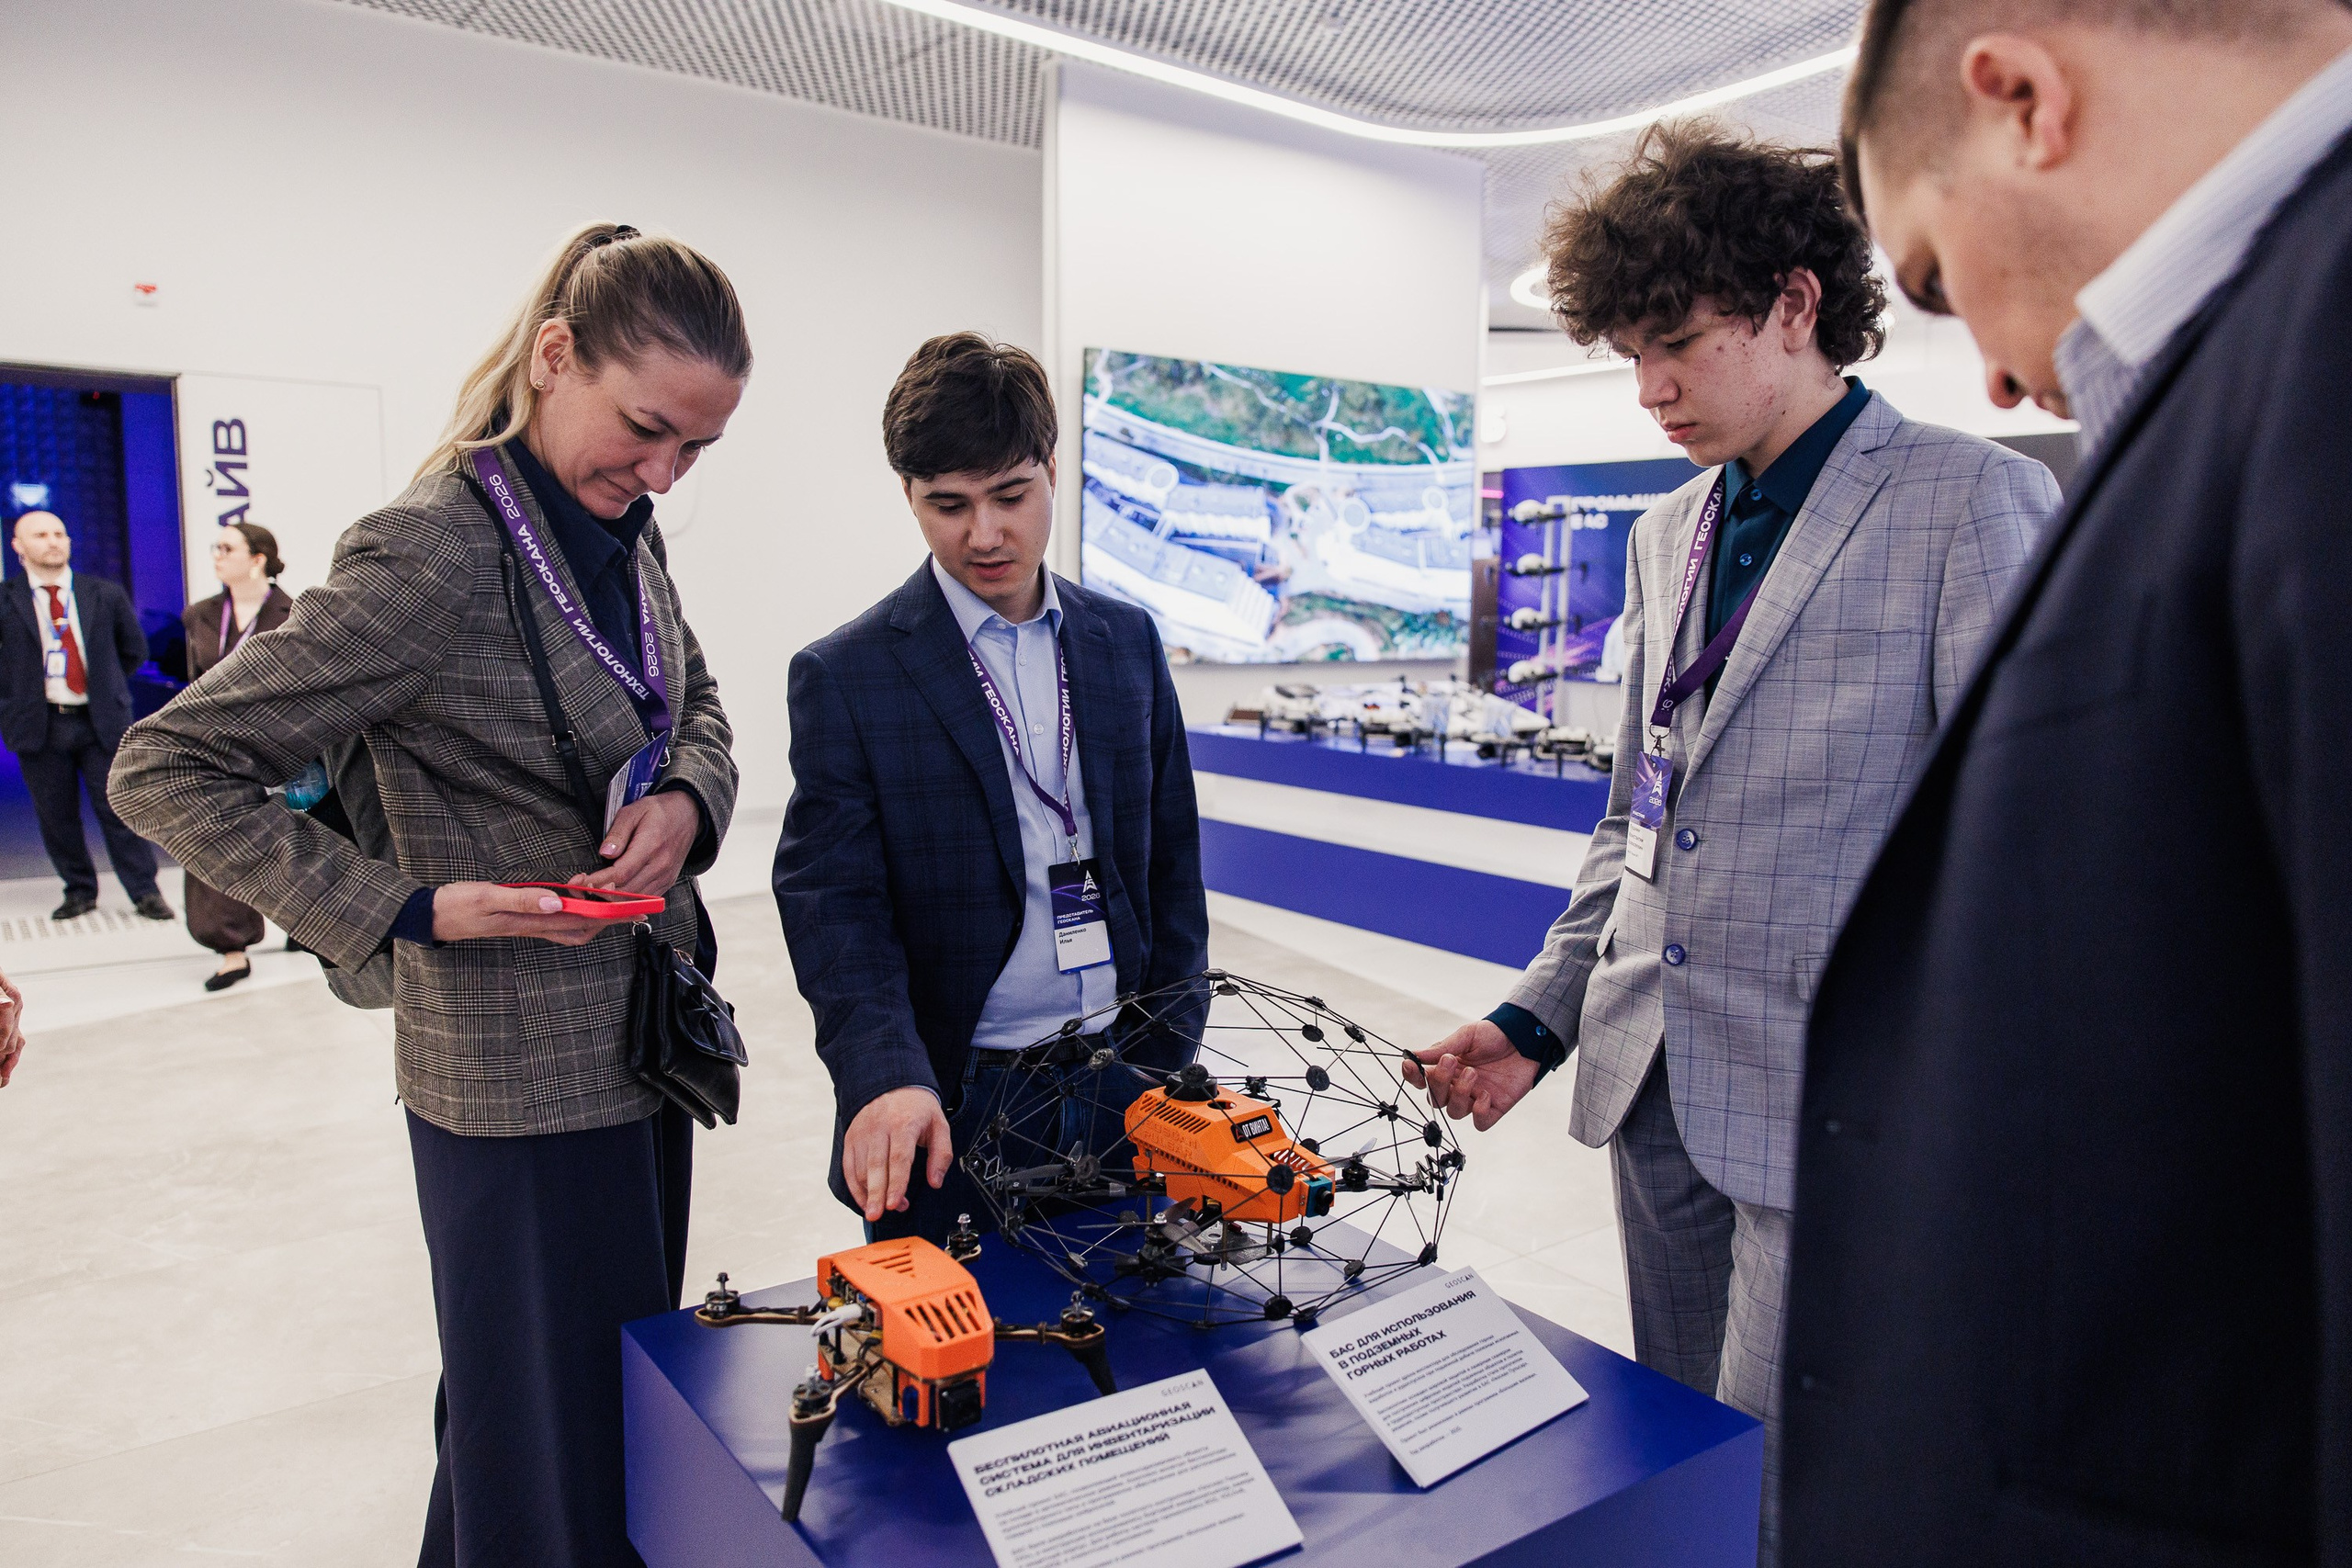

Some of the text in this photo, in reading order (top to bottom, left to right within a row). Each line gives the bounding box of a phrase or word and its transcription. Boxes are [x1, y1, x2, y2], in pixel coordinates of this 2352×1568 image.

[489, 474, 650, 700] ТЕХНОЛОГИИ ГЕОСКАНА 2026
[645, 632, 660, 677] 2026
[1081, 892, 1101, 902] 2026
[1443, 1272, 1475, 1289] GEOSCAN
[1329, 1290, 1476, 1358] БАС ДЛЯ ИСПОЛЬЗОВАНИЯ
[1337, 1326, 1423, 1369] В ПОДЗЕМНЫХ
[1345, 1329, 1447, 1380] ГОРНЫХ РАБОТАХ
[972, 1401, 1193, 1474] БЕСПИЛОТНАЯ АВИАЦИОННАЯ
[978, 1405, 1216, 1485] СИСТЕМА ДЛЯ ИНВЕНТАРИЗАЦИИ
[982, 1431, 1172, 1497] СКЛАДСКИХ ПОМЕЩЕНИЙ
